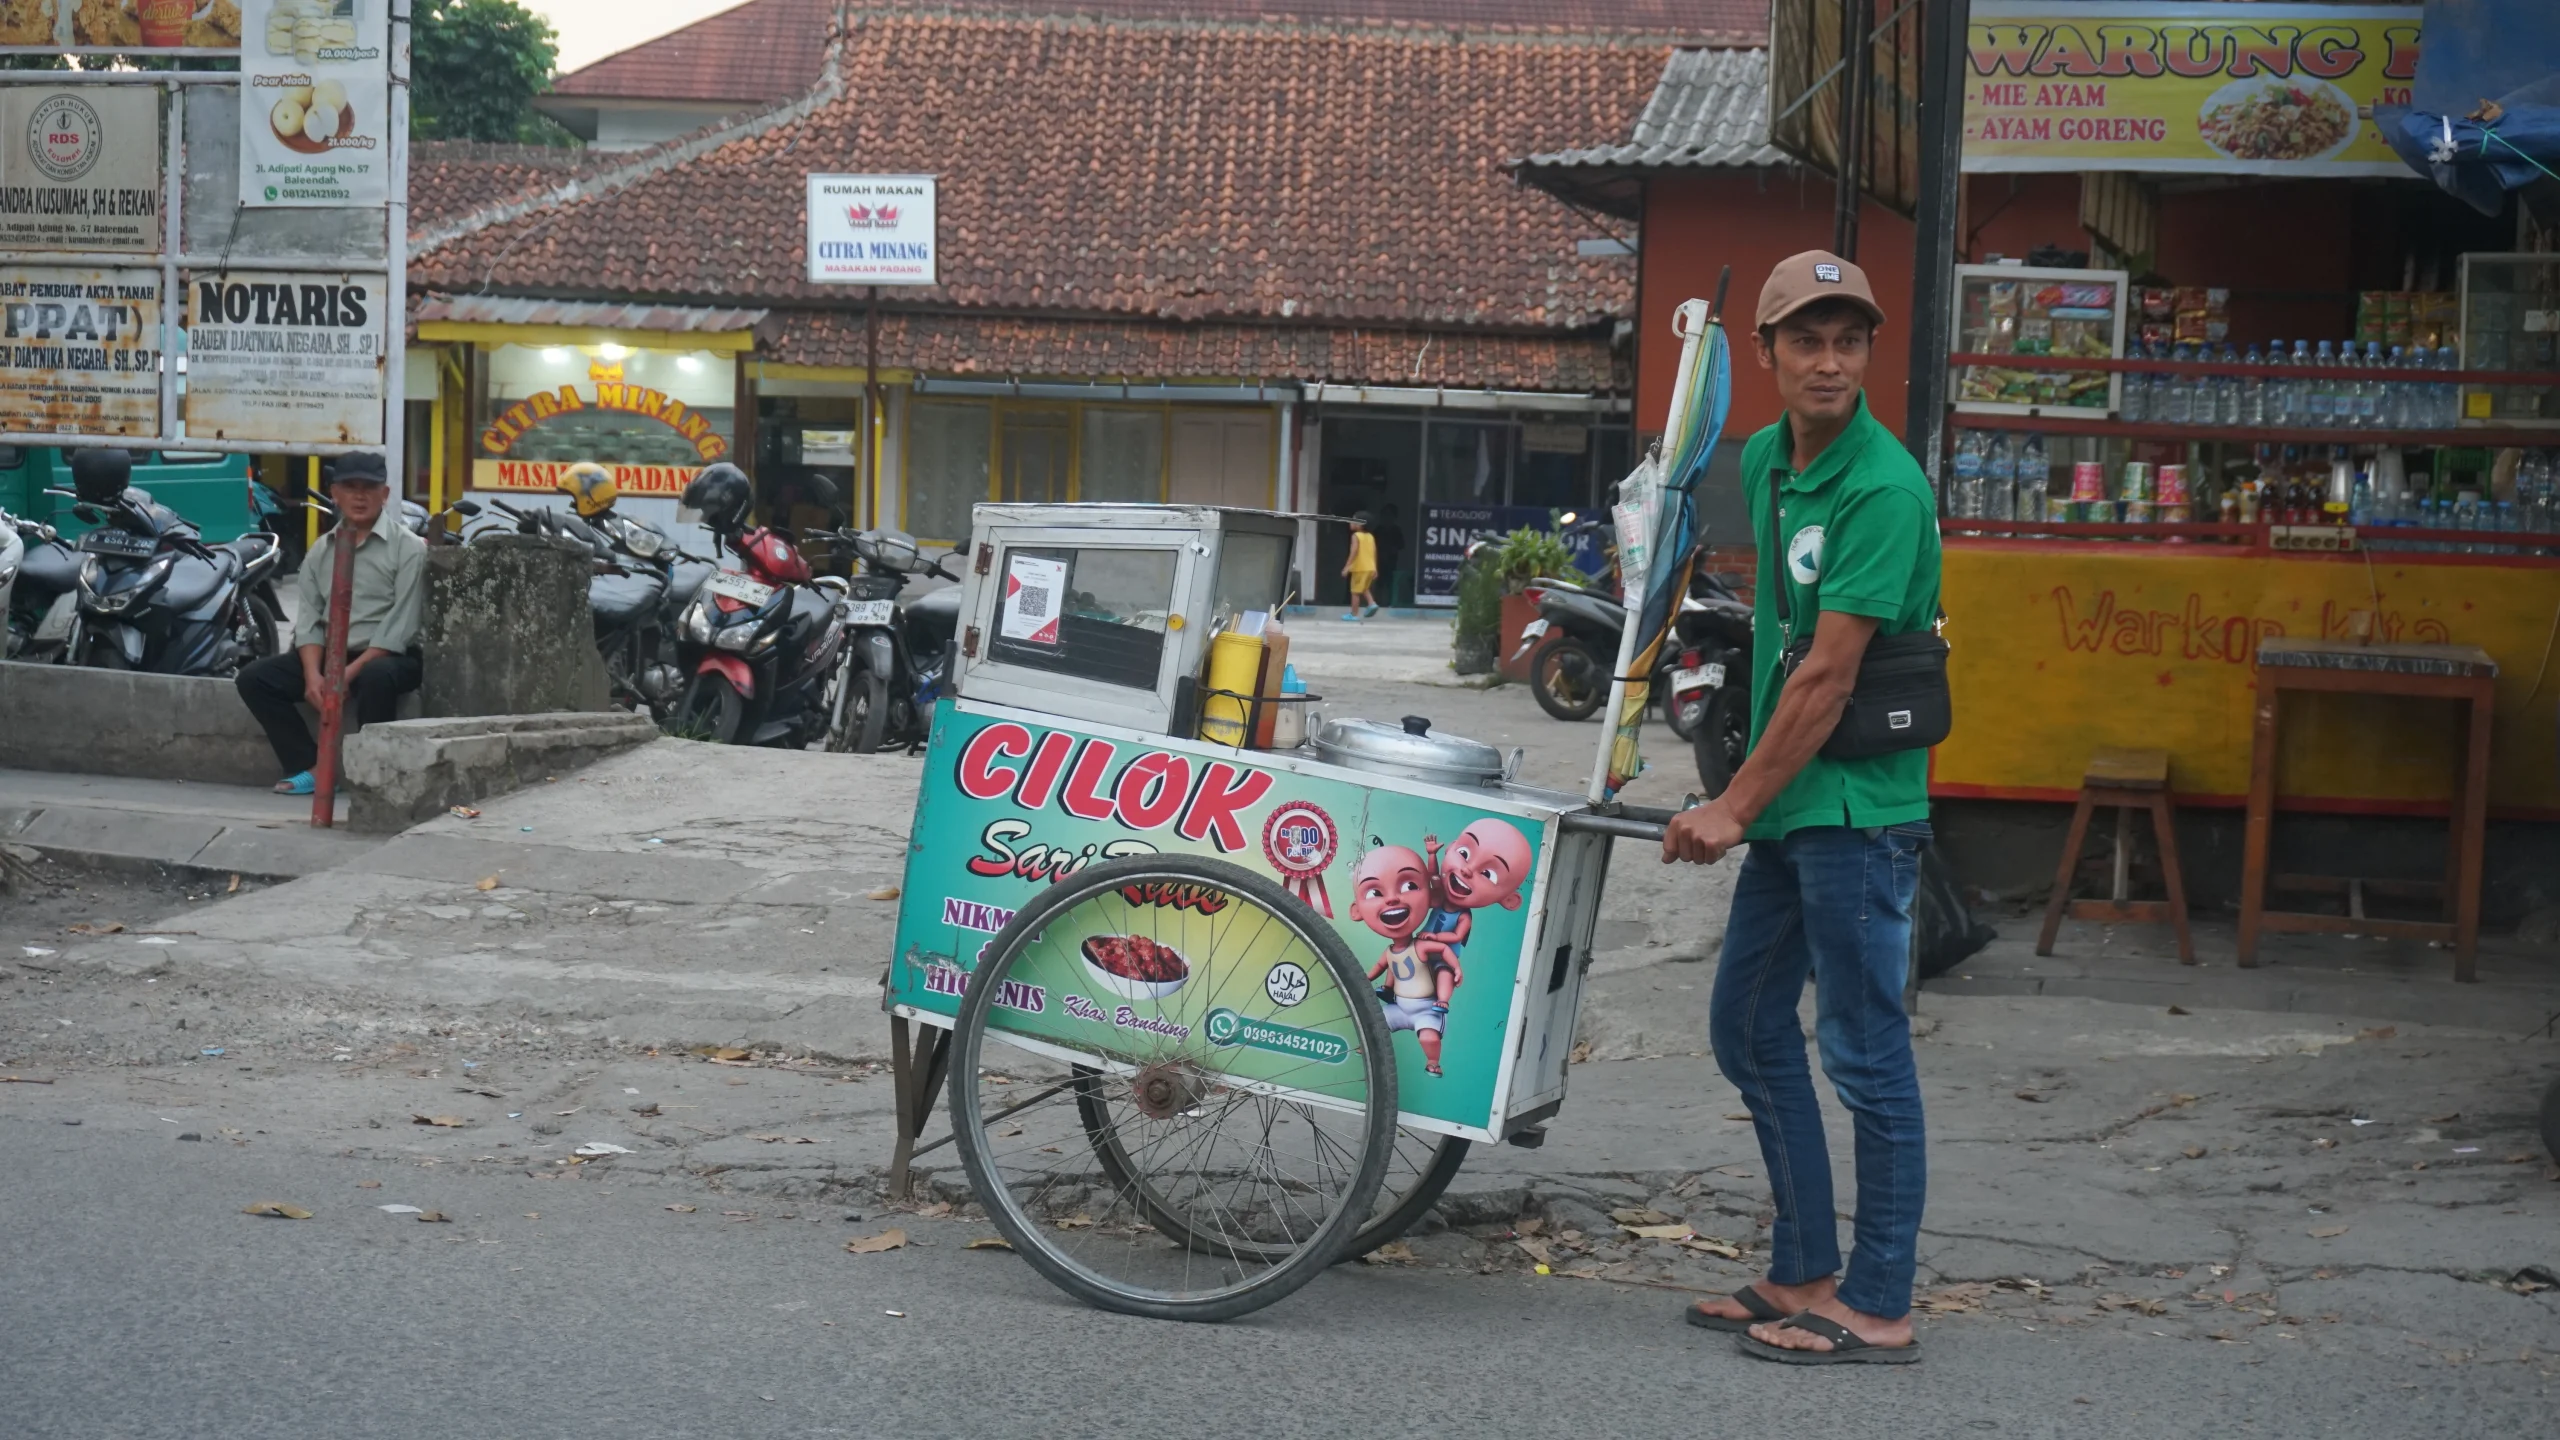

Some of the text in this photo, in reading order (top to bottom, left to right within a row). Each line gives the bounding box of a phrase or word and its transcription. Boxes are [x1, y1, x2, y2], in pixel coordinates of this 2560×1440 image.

[1966, 24, 2365, 79] WARUNG
[253, 75, 310, 87] Pear Madu
[1982, 84, 2106, 107] MIE AYAM
[35, 100, 94, 125] KANTOR HUKUM
[49, 133, 79, 144] RDS
[1981, 118, 2167, 141] AYAM GORENG
[326, 137, 376, 149] 21.000/kg
[268, 165, 302, 176] Adipati
[305, 165, 336, 175] Agung
[338, 165, 355, 173] No.
[357, 165, 369, 173] 57
[284, 176, 339, 185] Baleendah.
[823, 185, 924, 196] RUMAH MAKAN
[36, 187, 90, 220] KUSUMAH,
[93, 189, 107, 216] SH
[109, 189, 116, 216] &
[118, 190, 156, 217] REKAN
[6, 223, 35, 234] Adipati
[37, 224, 64, 234] Agung
[65, 225, 78, 233] No.
[80, 225, 91, 233] 57
[93, 225, 139, 234] Baleendah
[818, 240, 928, 261] CITRA MINANG
[824, 264, 922, 274] MASAKAN PADANG
[1817, 264, 1838, 273] ONE
[1818, 273, 1839, 282] TIME
[29, 283, 83, 299] PEMBUAT
[86, 285, 115, 300] AKTA
[117, 285, 155, 301] TANAH
[199, 282, 367, 328] NOTARIS
[192, 329, 228, 351] RADEN
[231, 330, 284, 352] DJATNIKA
[14, 346, 64, 370] DJATNIKA
[481, 383, 729, 461] CITRA MINANG
[1439, 510, 1492, 520] TEXOLOGY
[2052, 585, 2285, 675] Warkop
[805, 632, 834, 663] VARIO
[953, 722, 1274, 854] CILOK
[966, 818, 1098, 885] Sari
[1273, 990, 1298, 1002] HALAL
[1063, 995, 1191, 1044] Khas Bandung
[1242, 1025, 1342, 1057] 089634521027
